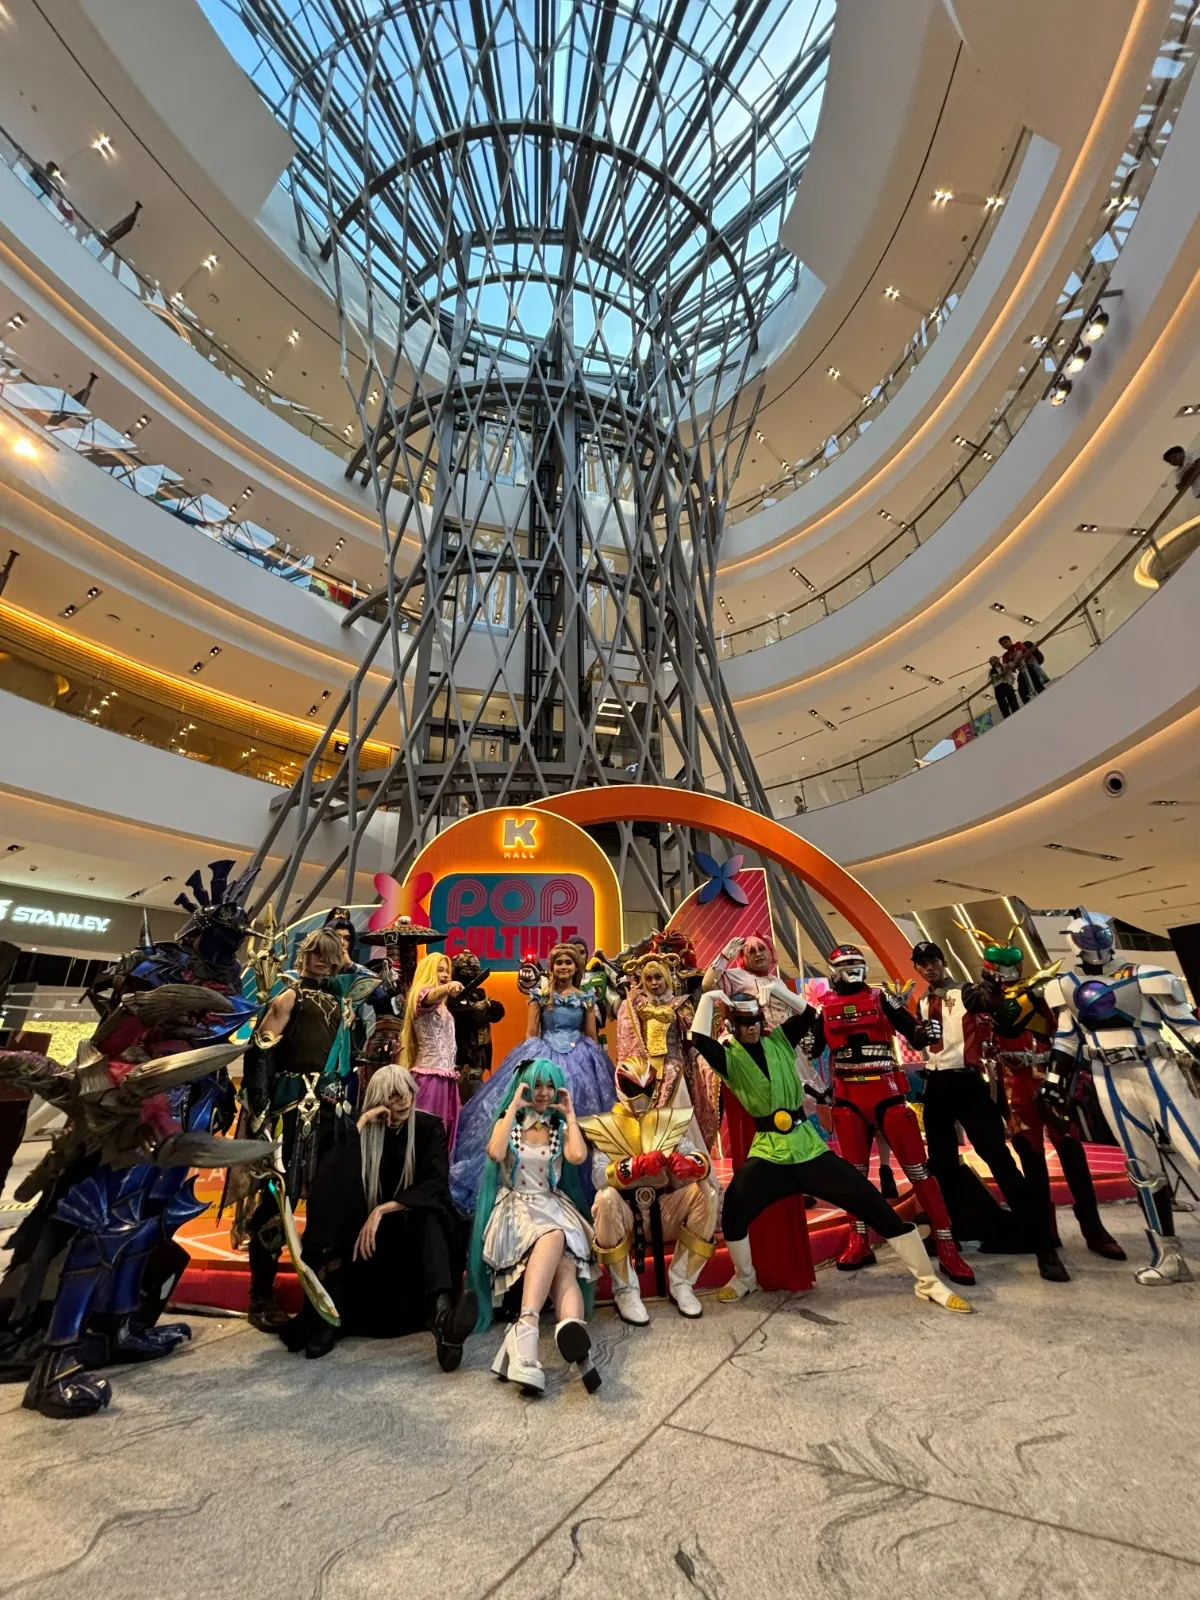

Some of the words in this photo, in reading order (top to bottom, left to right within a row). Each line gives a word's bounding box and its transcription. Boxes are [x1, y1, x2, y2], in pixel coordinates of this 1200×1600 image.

[503, 817, 537, 848] K
[503, 851, 535, 859] MALL
[446, 879, 578, 923] POP
